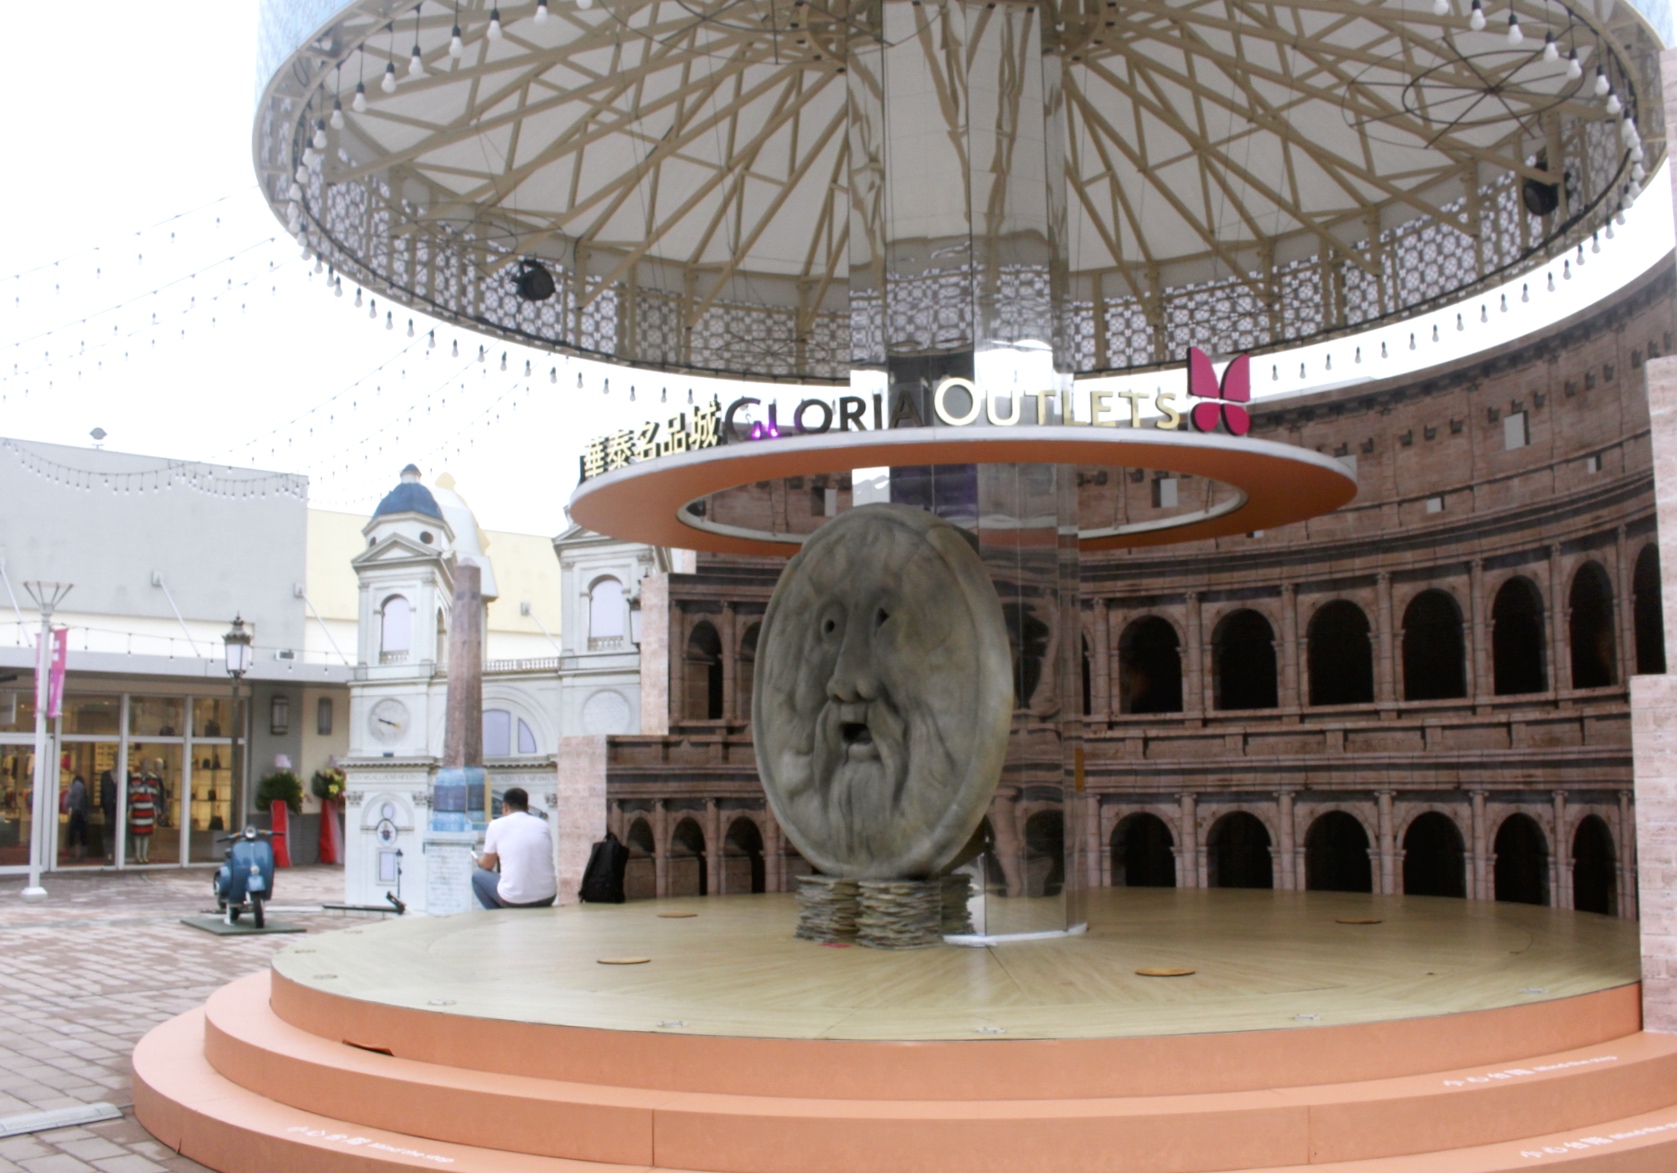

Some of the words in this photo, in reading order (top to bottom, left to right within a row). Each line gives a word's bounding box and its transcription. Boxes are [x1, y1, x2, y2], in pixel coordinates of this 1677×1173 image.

[580, 400, 721, 478] 華泰名品城
[725, 389, 923, 441] GLORIA
[934, 377, 1181, 430] OUTLETS
